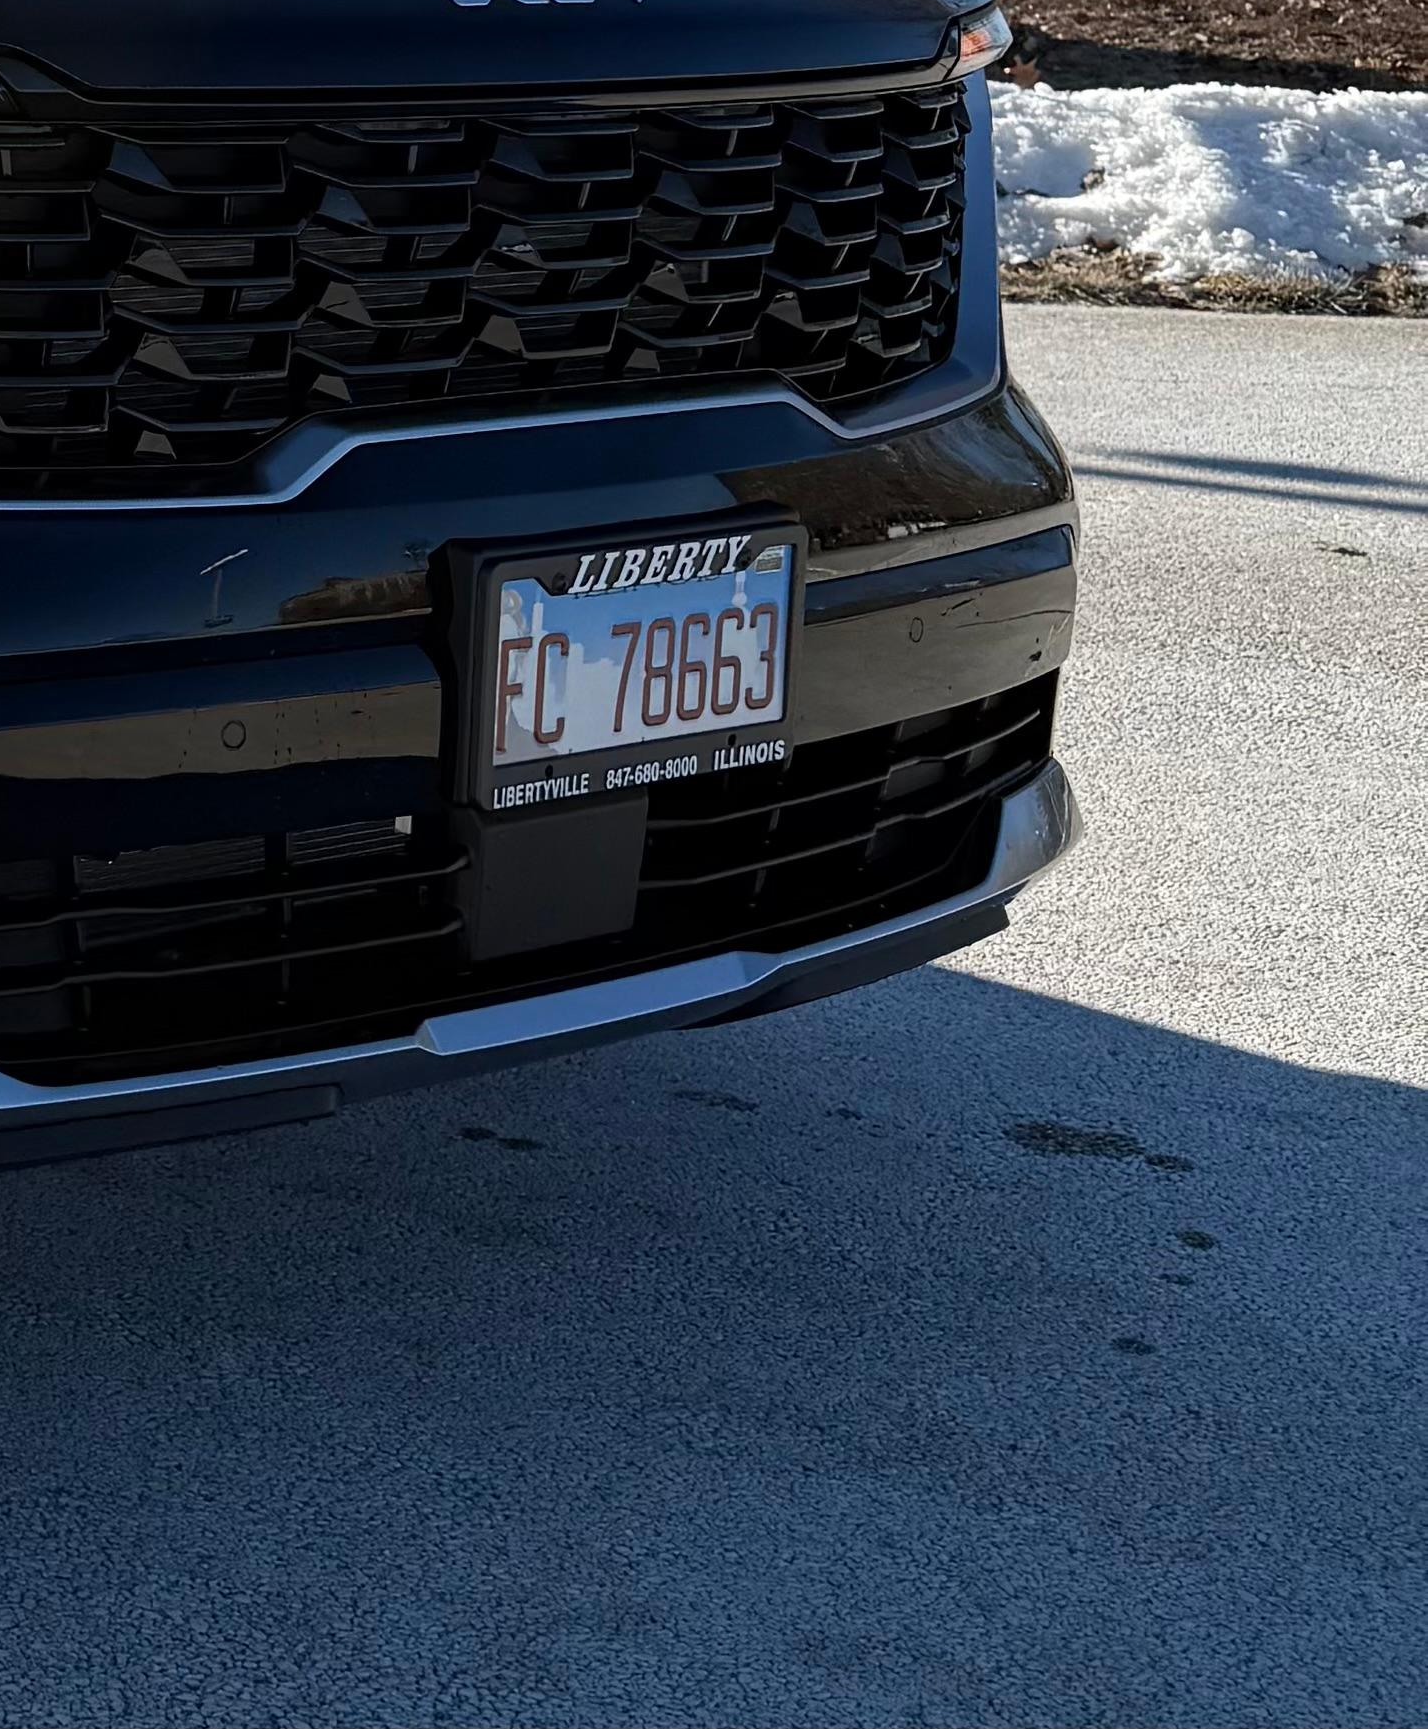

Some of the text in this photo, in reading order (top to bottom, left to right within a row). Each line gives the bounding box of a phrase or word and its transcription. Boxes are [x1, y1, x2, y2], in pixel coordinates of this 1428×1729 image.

[567, 534, 752, 595] LIBERTY
[495, 602, 778, 754] FC 78663
[493, 739, 786, 810] LIBERTYVILLE 847-680-8000 ILLINOIS
